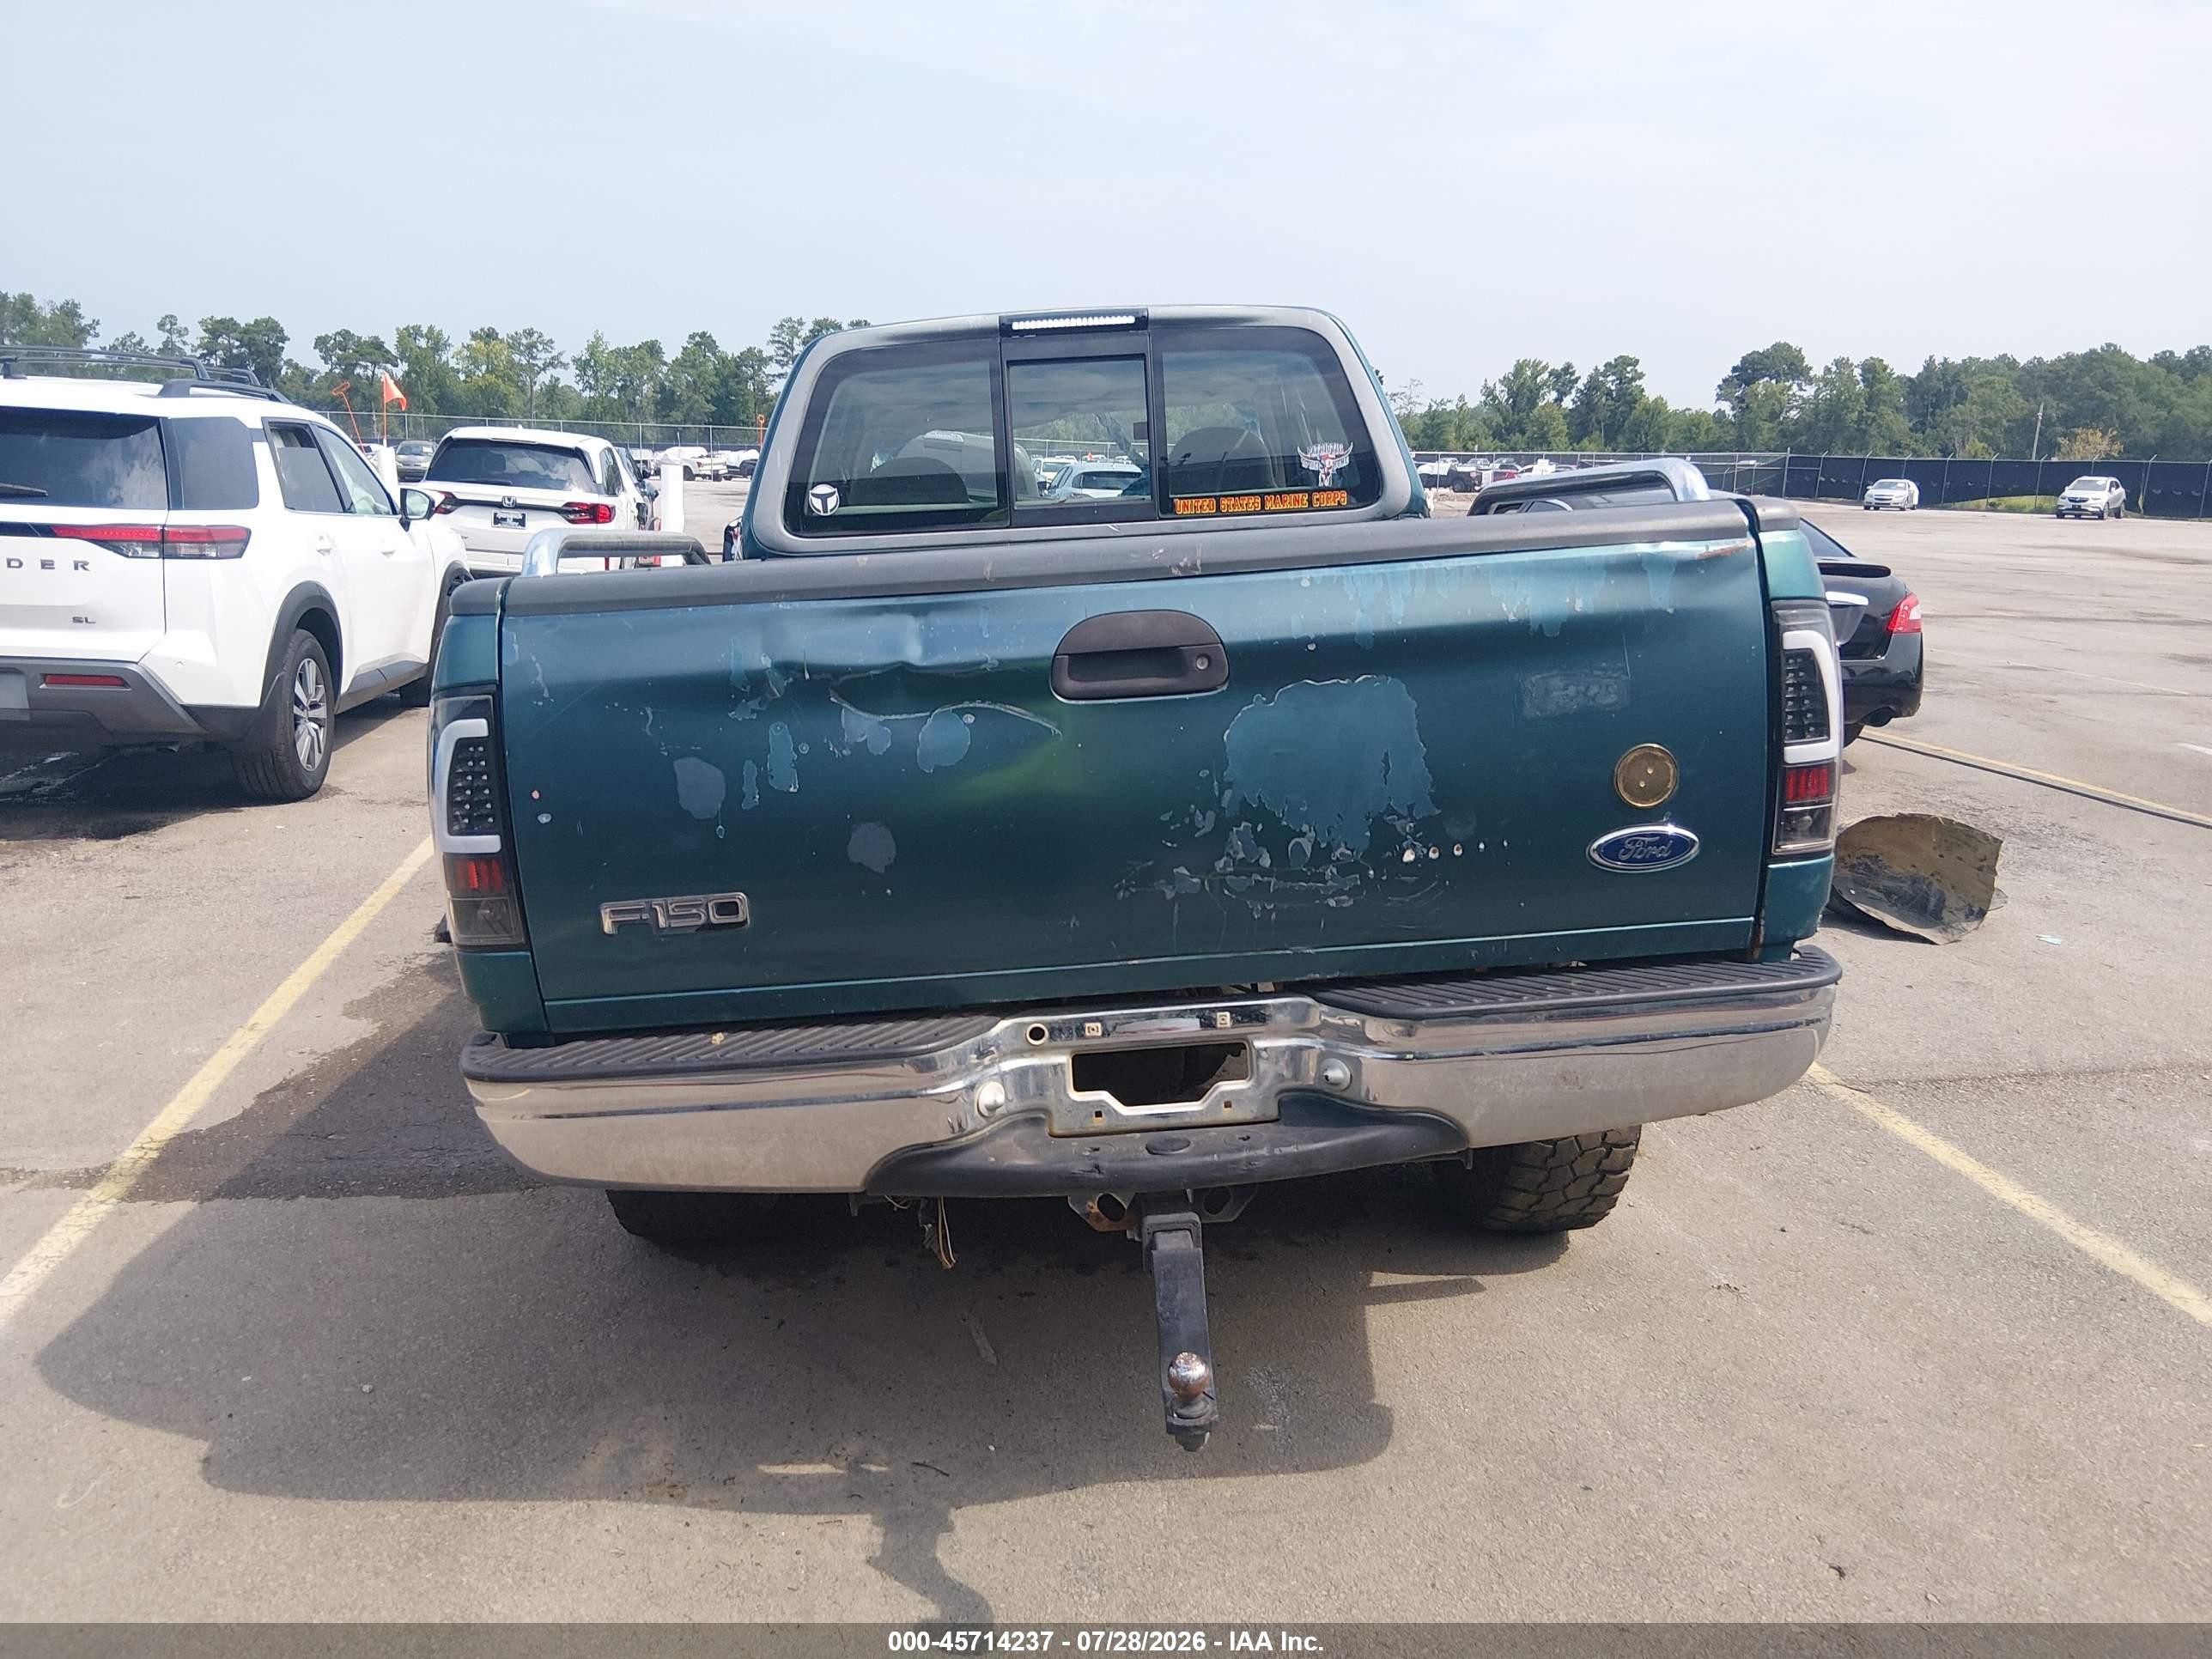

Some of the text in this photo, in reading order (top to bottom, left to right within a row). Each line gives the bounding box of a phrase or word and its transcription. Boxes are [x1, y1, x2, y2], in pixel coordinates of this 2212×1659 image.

[1174, 490, 1347, 514] UNITED STATES MARINE CORPS
[1618, 836, 1674, 861] Ford
